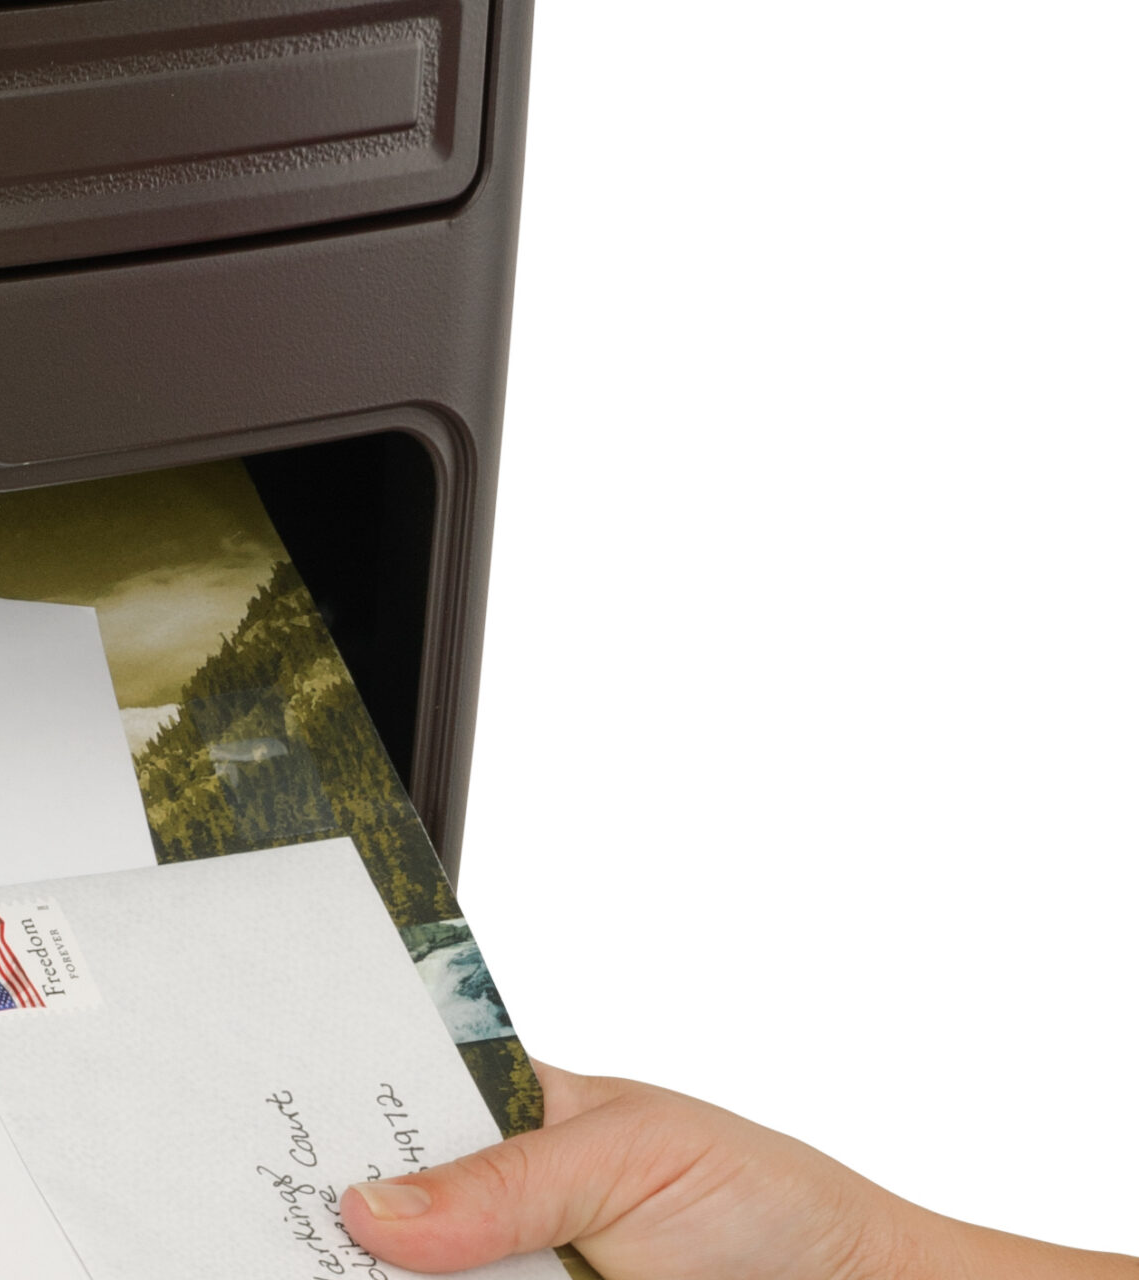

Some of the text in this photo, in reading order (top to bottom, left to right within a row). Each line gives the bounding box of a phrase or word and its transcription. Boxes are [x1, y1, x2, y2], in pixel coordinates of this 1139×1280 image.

[21, 918, 65, 996] Freedom
[50, 929, 79, 979] FOREVER
[266, 1091, 318, 1167] Court
